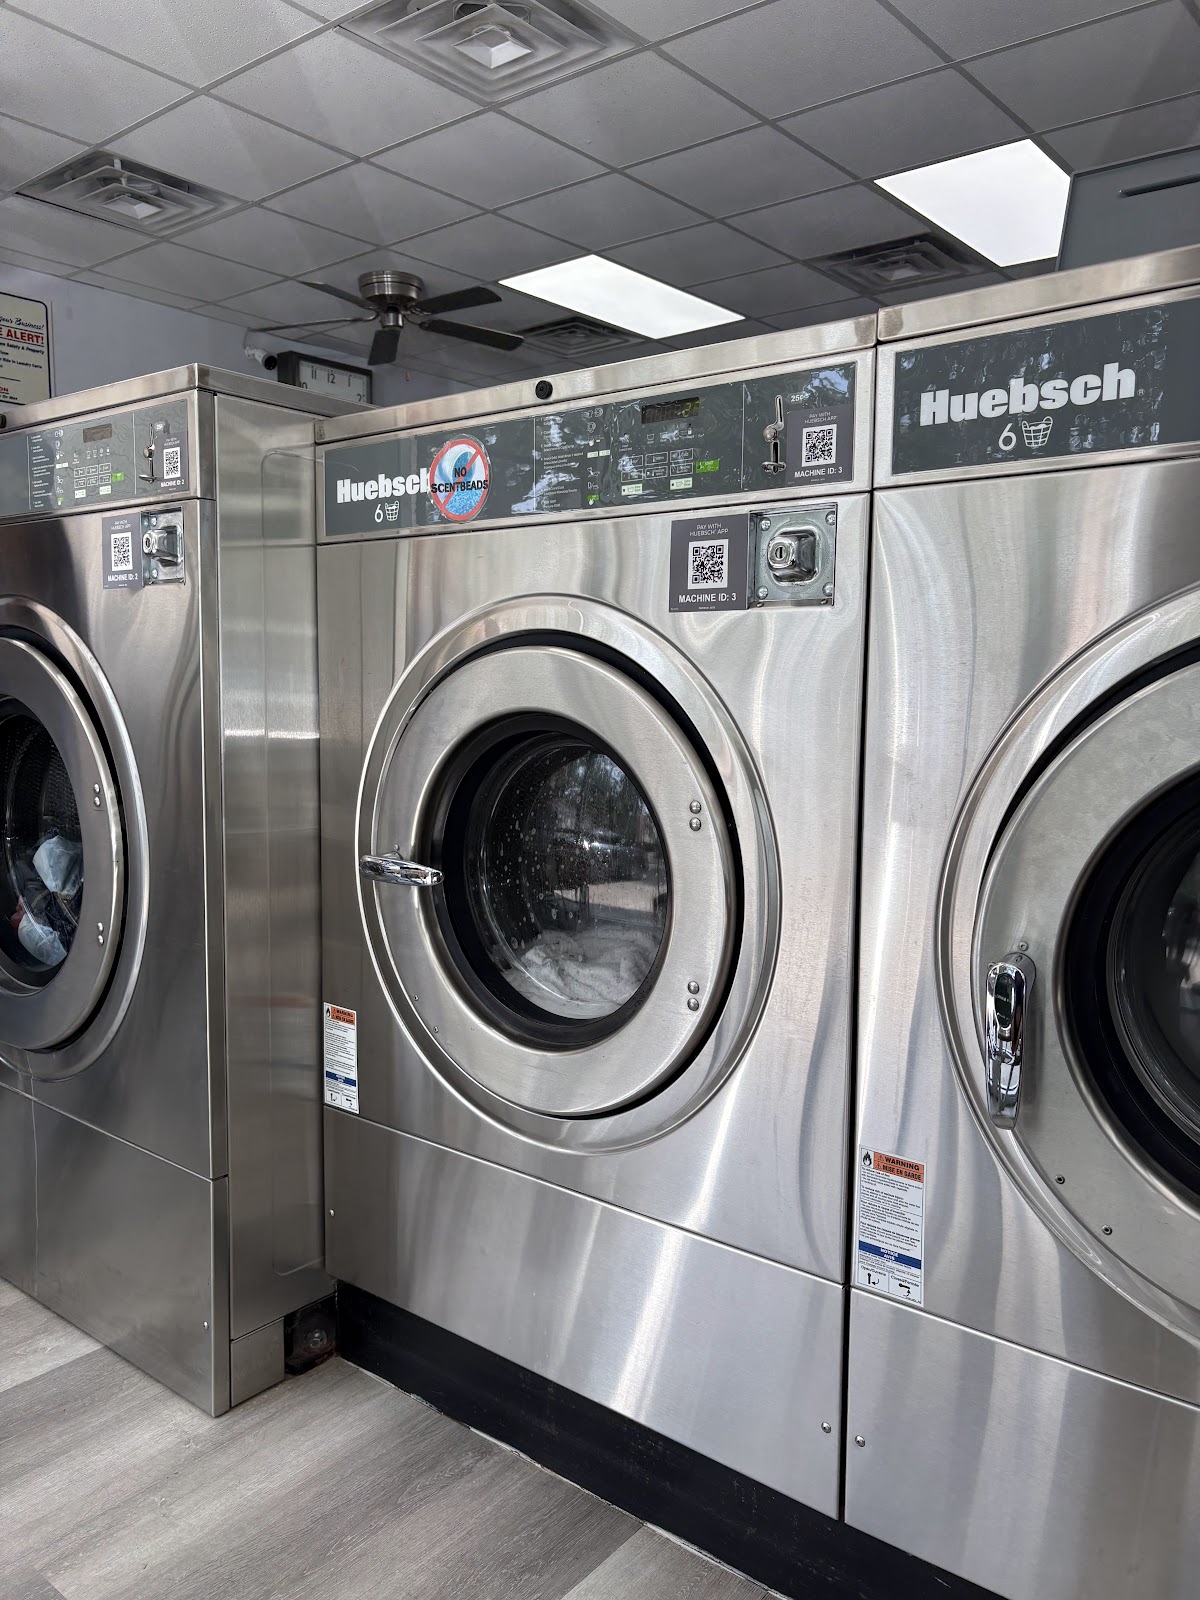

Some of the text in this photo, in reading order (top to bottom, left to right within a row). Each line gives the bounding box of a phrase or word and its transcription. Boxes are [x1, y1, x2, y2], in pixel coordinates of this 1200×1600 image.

[6, 328, 44, 344] ALERT!
[328, 372, 336, 384] 12
[998, 423, 1017, 451] 6
[454, 467, 467, 477] NO
[794, 468, 826, 478] MACHINE
[430, 480, 489, 493] SCENTBEADS
[374, 504, 383, 522] 6
[678, 593, 736, 603] MACHINE ID: 3
[885, 1156, 919, 1171] WARNING
[882, 1165, 895, 1173] MISE
[904, 1171, 921, 1180] GARDE
